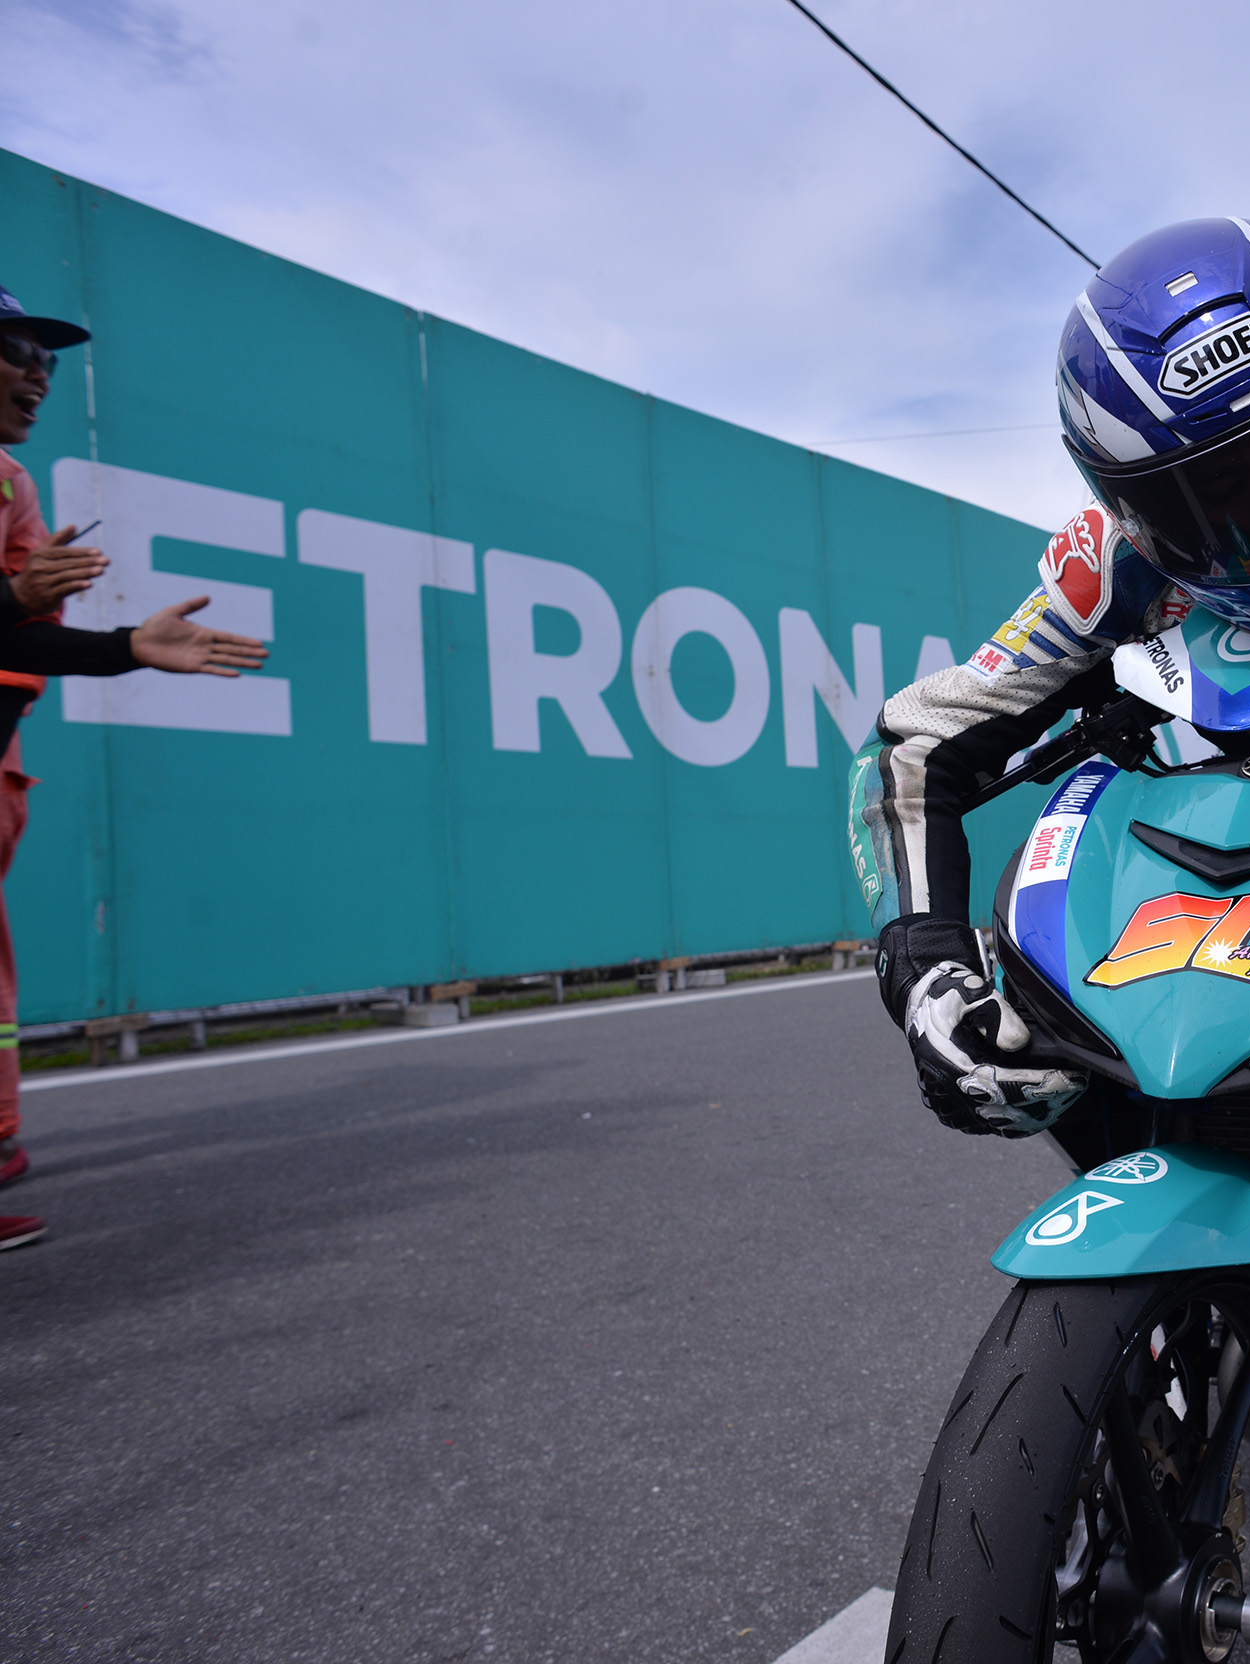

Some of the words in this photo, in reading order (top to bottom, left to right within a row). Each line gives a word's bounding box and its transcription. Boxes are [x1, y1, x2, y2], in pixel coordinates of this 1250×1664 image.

[51, 456, 956, 769] ETRON
[1051, 774, 1105, 815] YAMAHA
[1029, 826, 1062, 871] Sprinta
[1055, 825, 1078, 867] PETRONAS
